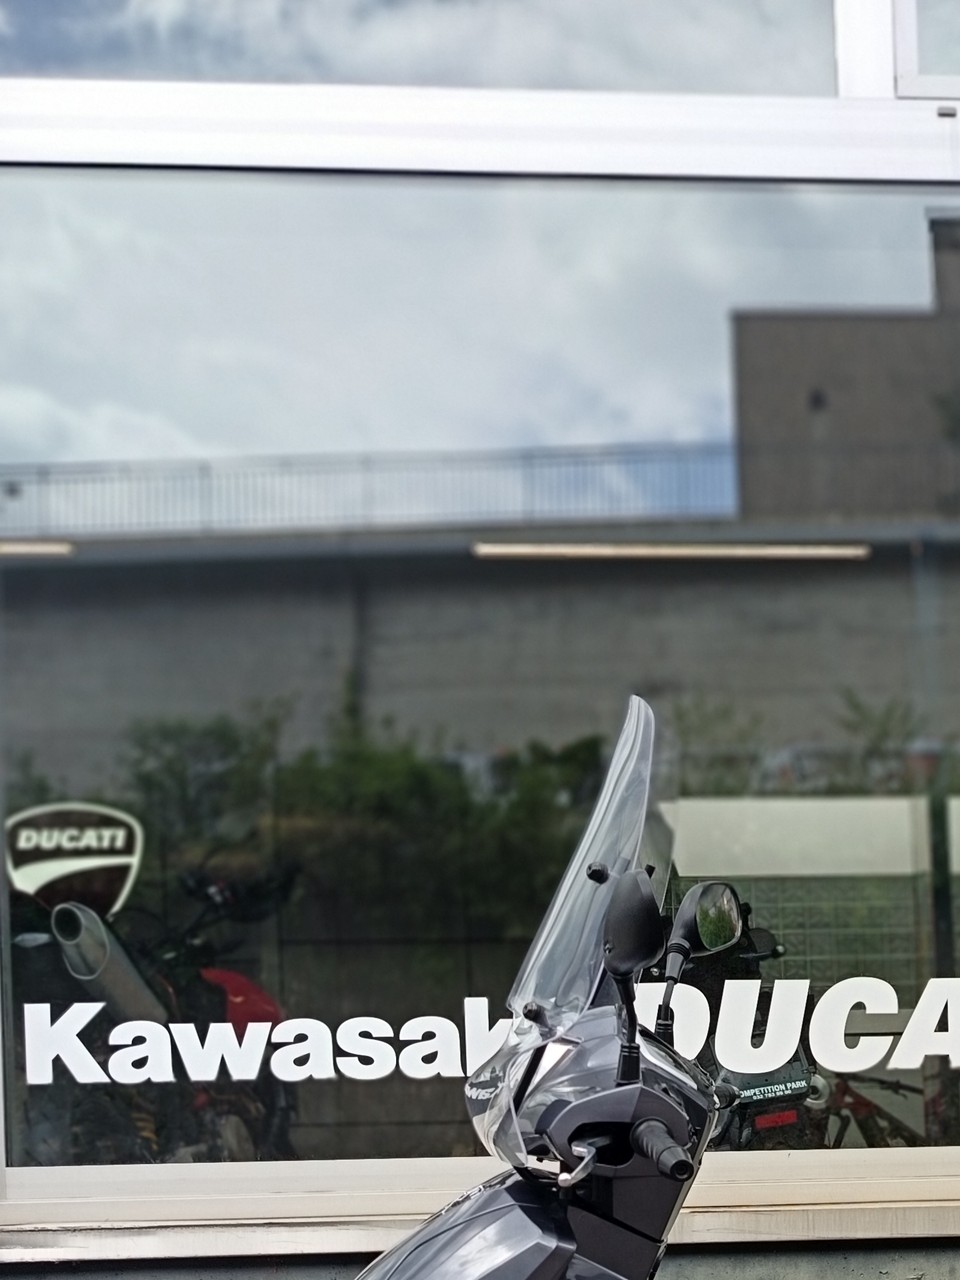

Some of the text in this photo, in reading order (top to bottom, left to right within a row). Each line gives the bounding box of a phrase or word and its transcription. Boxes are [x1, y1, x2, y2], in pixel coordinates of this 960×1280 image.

[17, 827, 126, 850] DUCATI
[23, 996, 515, 1085] Kawasak
[740, 1080, 807, 1098] OMPETITION PARK
